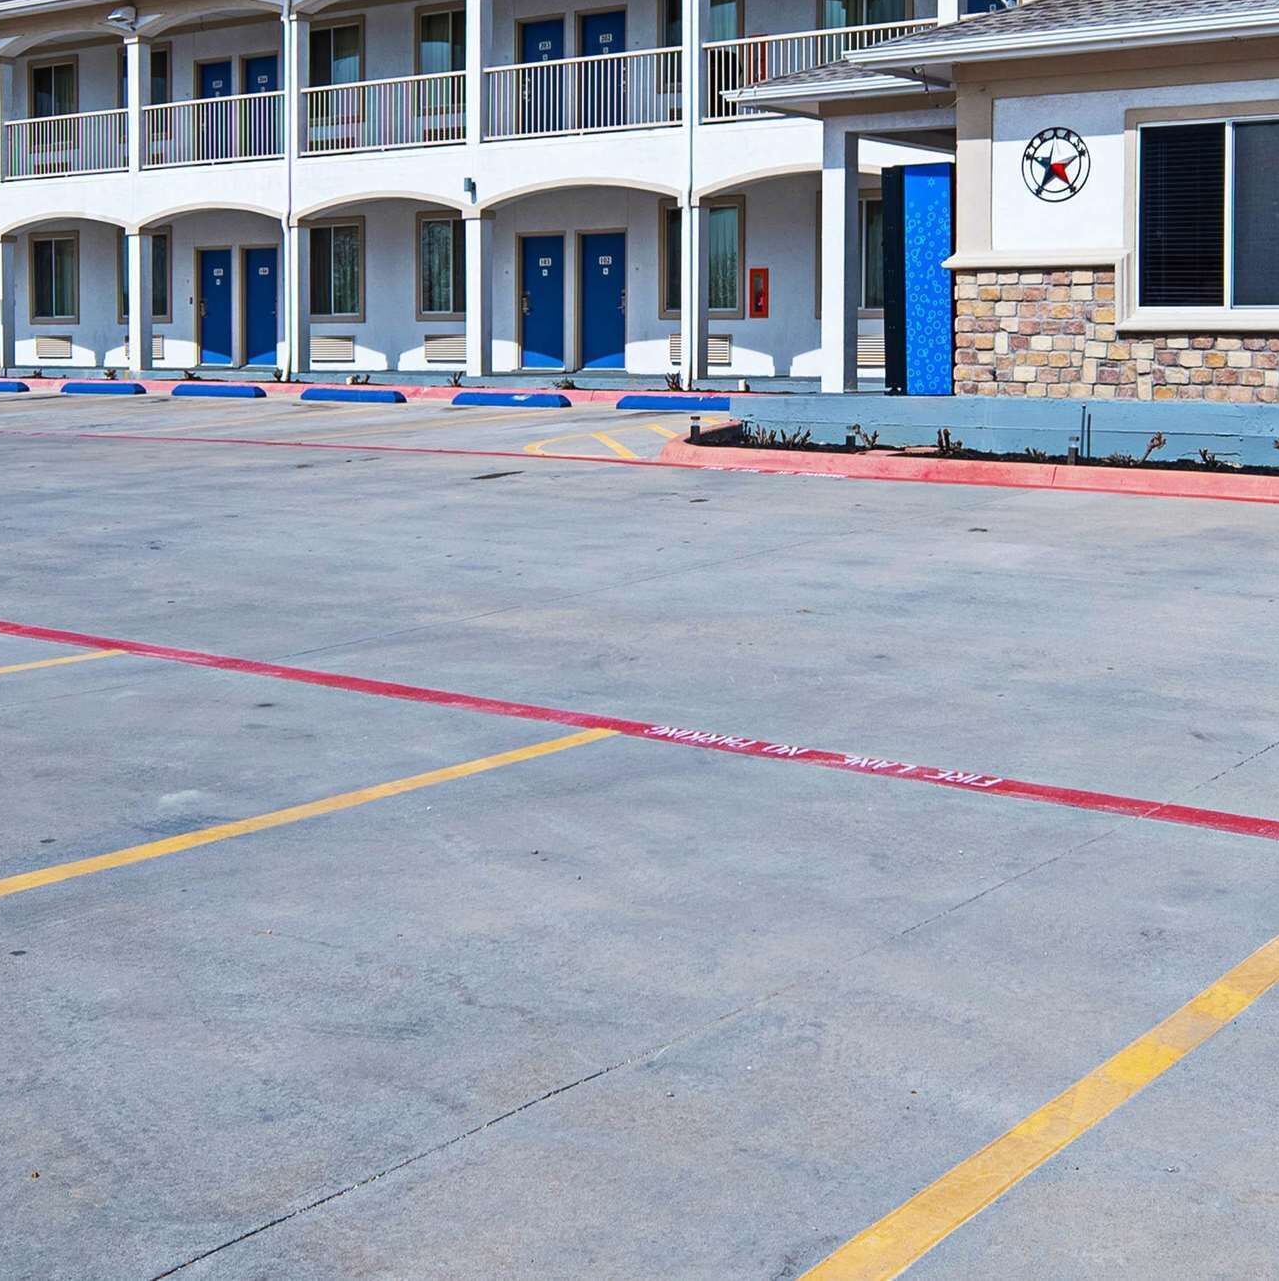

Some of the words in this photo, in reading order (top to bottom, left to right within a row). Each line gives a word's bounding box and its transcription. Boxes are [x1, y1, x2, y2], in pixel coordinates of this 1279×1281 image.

[1026, 127, 1083, 151] TEXAS
[644, 725, 757, 748] PARKING
[761, 744, 809, 756] NO
[843, 754, 917, 773] LANE
[924, 768, 1002, 787] FIRE
